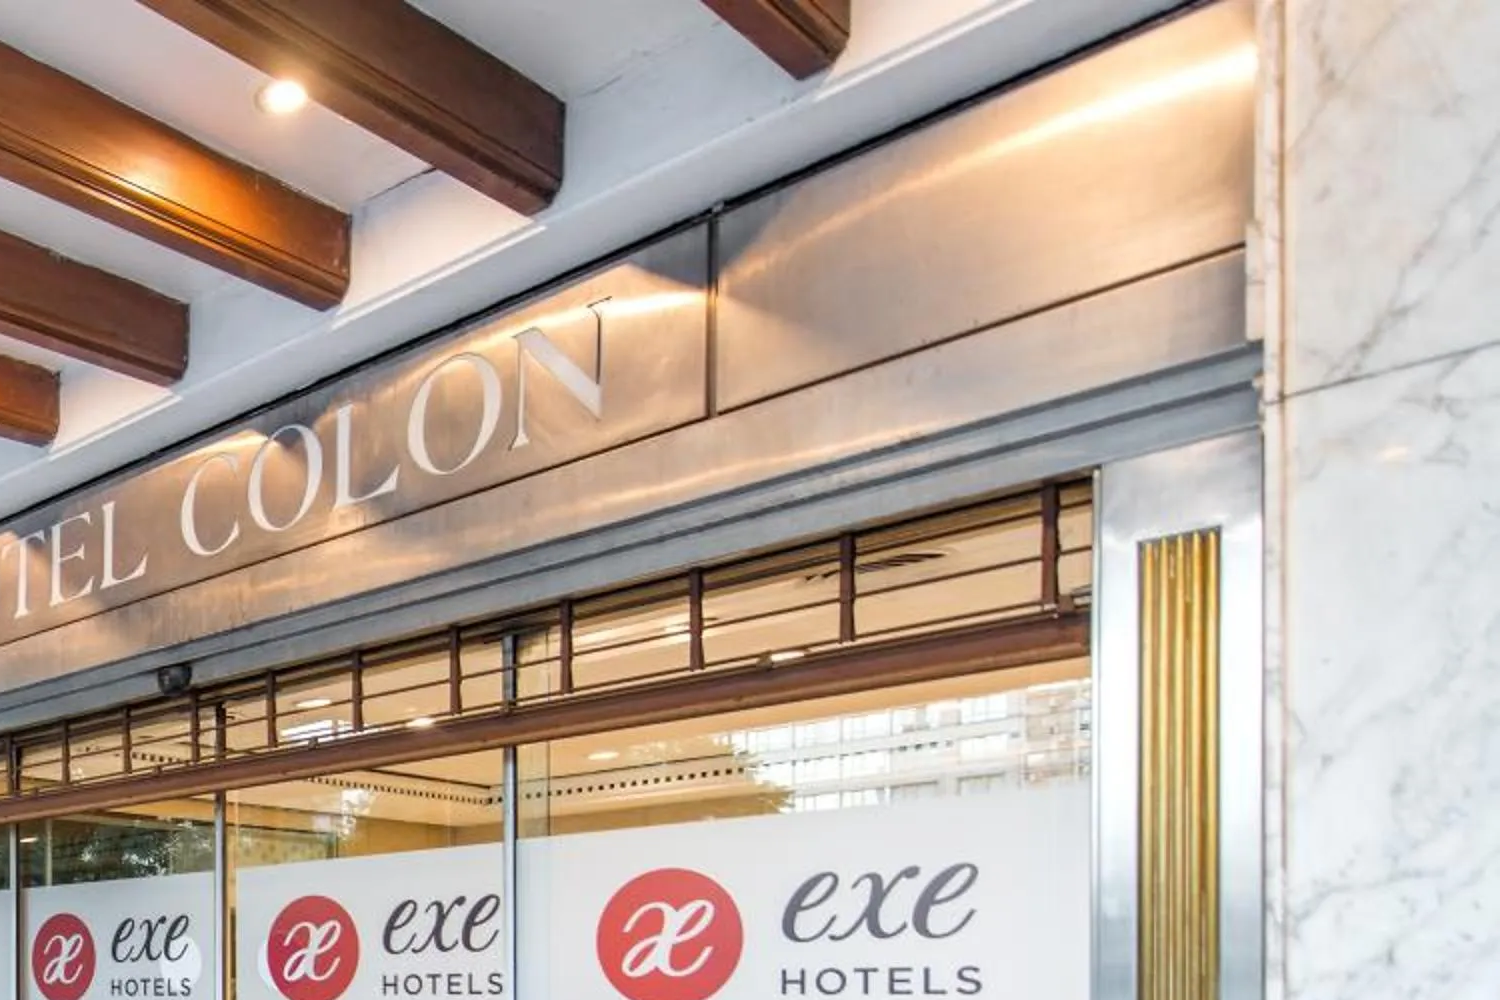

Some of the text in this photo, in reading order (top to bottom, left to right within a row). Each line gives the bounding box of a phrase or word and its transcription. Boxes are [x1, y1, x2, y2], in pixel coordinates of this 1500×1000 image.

[180, 296, 613, 557] COLON
[382, 893, 501, 954] exe
[781, 862, 979, 943] exe
[111, 913, 190, 963] exe
[111, 978, 192, 997] HOTELS
[382, 973, 503, 996] HOTELS
[780, 966, 983, 996] HOTELS
